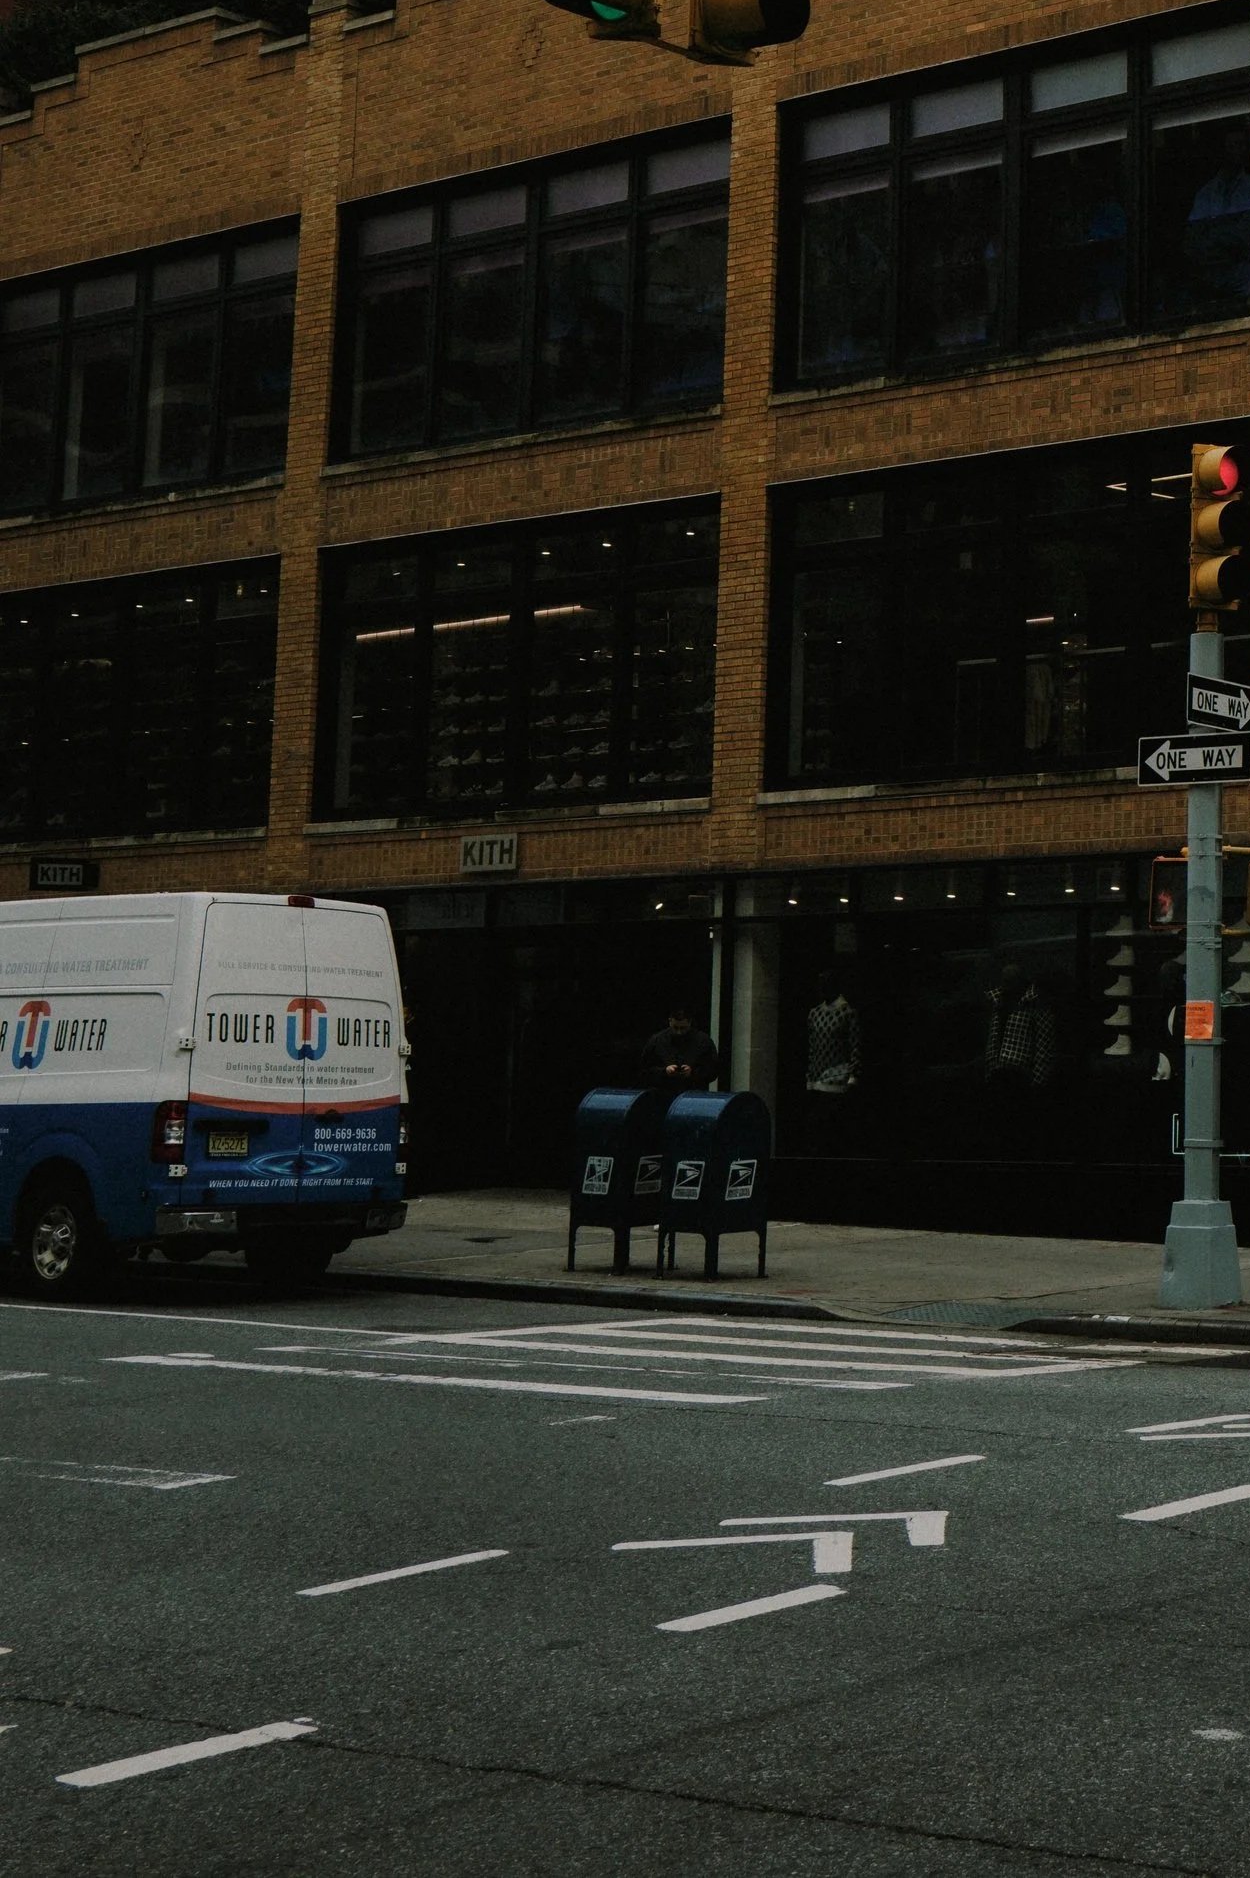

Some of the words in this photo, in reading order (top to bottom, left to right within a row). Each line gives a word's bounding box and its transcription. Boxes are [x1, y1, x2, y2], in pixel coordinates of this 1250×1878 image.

[1197, 691, 1219, 712] ONE
[1228, 698, 1250, 719] WAY
[1156, 750, 1187, 770] ONE
[1202, 748, 1237, 767] WAY
[463, 838, 514, 867] KITH
[40, 866, 81, 883] KITH
[62, 960, 93, 973] WATER
[95, 958, 150, 972] TREATMENT
[54, 1018, 107, 1052] WATER
[207, 1013, 275, 1044] TOWER
[337, 1017, 391, 1048] WATER
[226, 1062, 262, 1073] Defining
[265, 1062, 304, 1072] Standards
[307, 1063, 315, 1072] in
[317, 1065, 339, 1073] water
[340, 1065, 375, 1074] treatment
[246, 1076, 258, 1084] for
[260, 1076, 273, 1084] the
[276, 1076, 294, 1084] New
[297, 1076, 313, 1085] York
[316, 1077, 338, 1085] Metro
[340, 1077, 358, 1085] Area
[314, 1128, 377, 1141] 800-669-9636
[314, 1142, 392, 1152] towerwater.com
[209, 1180, 232, 1188] WHEN
[234, 1179, 249, 1187] YOU
[250, 1179, 269, 1187] NEED
[271, 1179, 279, 1187] IT
[280, 1179, 298, 1187] DONE
[302, 1178, 322, 1186] RIGHT
[323, 1178, 342, 1186] FROM
[343, 1178, 354, 1186] THE
[355, 1177, 374, 1186] START
